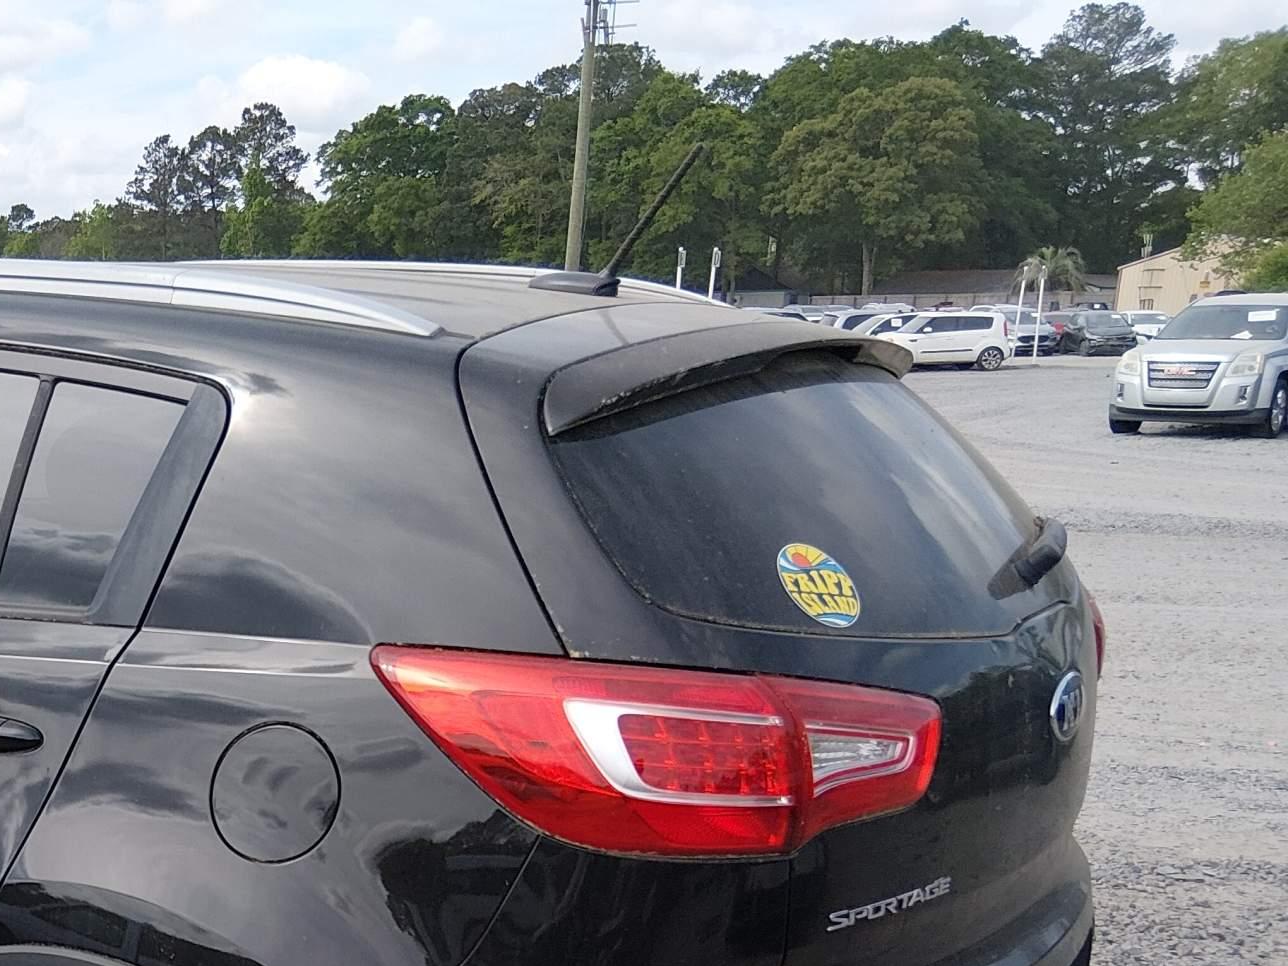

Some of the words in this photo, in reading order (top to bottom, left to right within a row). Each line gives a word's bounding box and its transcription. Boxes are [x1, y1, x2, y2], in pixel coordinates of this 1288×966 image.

[781, 570, 854, 597] FRIPP
[791, 592, 858, 617] ISLAND
[826, 876, 952, 932] SPORTAGE
